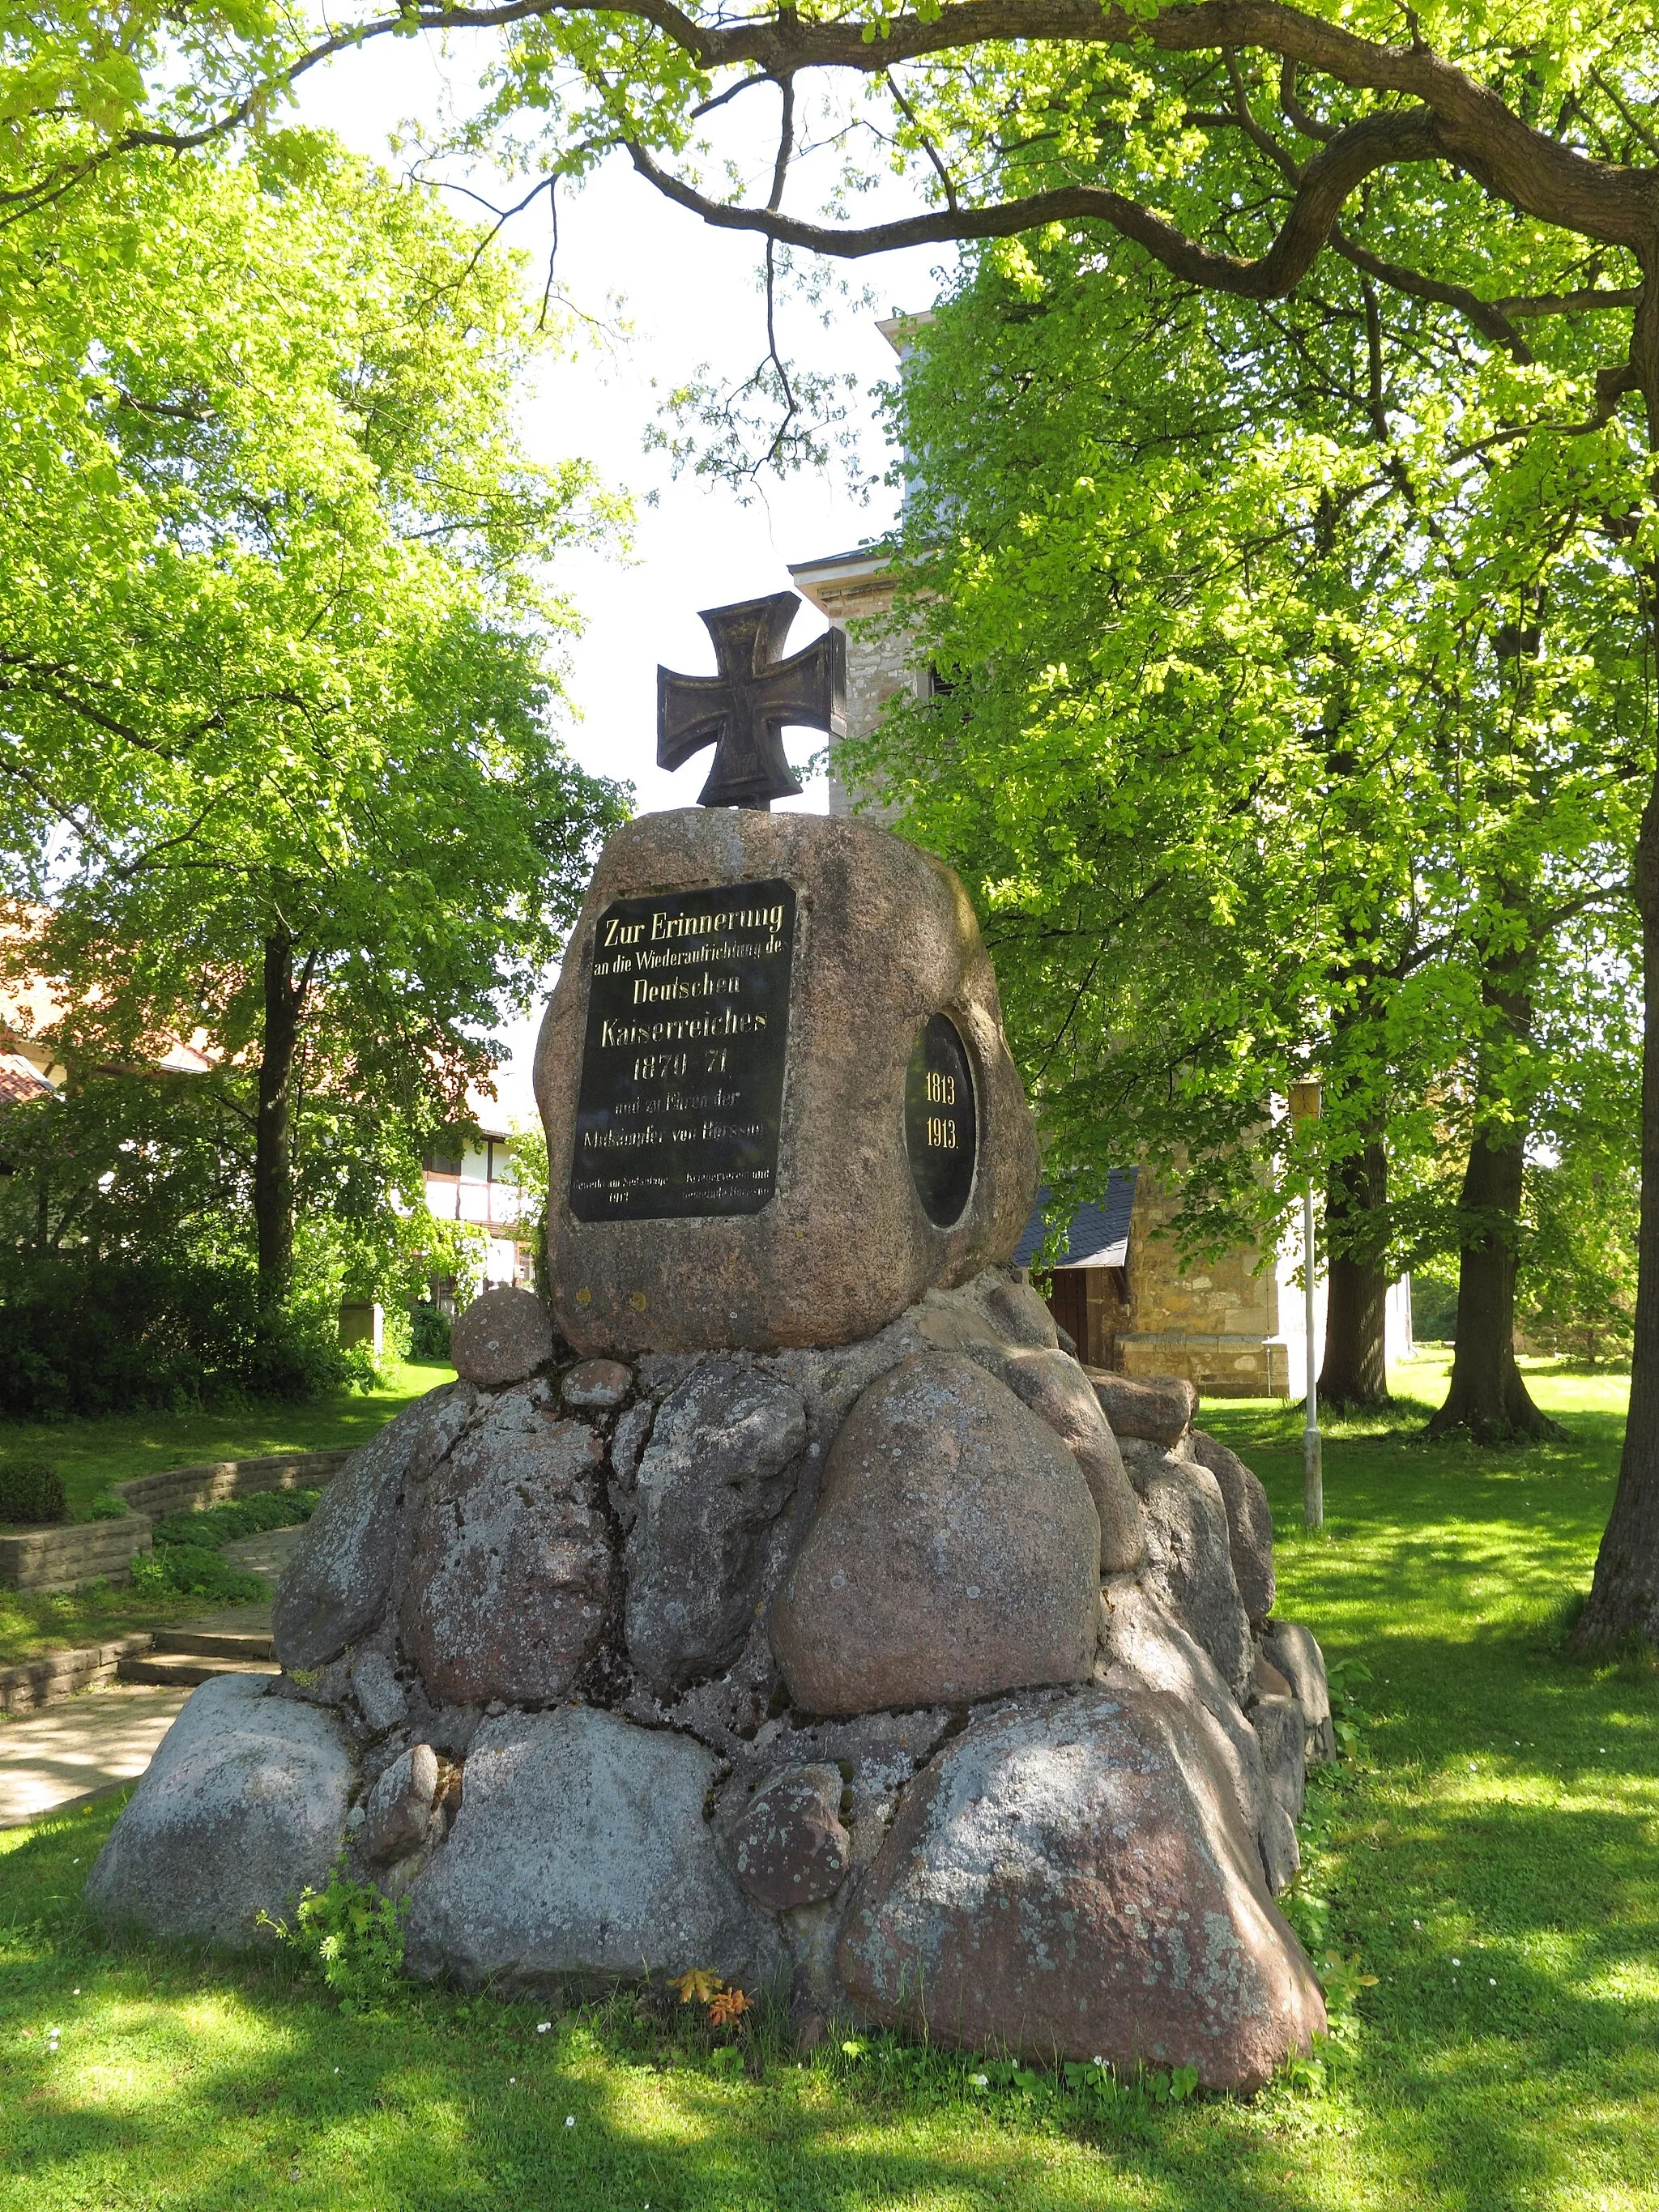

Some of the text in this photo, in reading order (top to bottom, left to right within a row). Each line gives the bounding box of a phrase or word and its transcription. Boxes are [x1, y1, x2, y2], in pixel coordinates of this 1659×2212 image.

[603, 905, 785, 947] Zur Erinnerung
[594, 961, 609, 976] an
[612, 954, 632, 974] die
[635, 940, 761, 970] Wiederaufrichtung
[633, 971, 740, 1004] Deutschen
[601, 1005, 768, 1048] Kaiserreiches
[634, 1053, 687, 1080] 1870
[614, 1096, 640, 1115] und
[666, 1091, 708, 1111] Ehren
[710, 1087, 740, 1106] der
[926, 1072, 955, 1105] 1813
[672, 1127, 697, 1142] von
